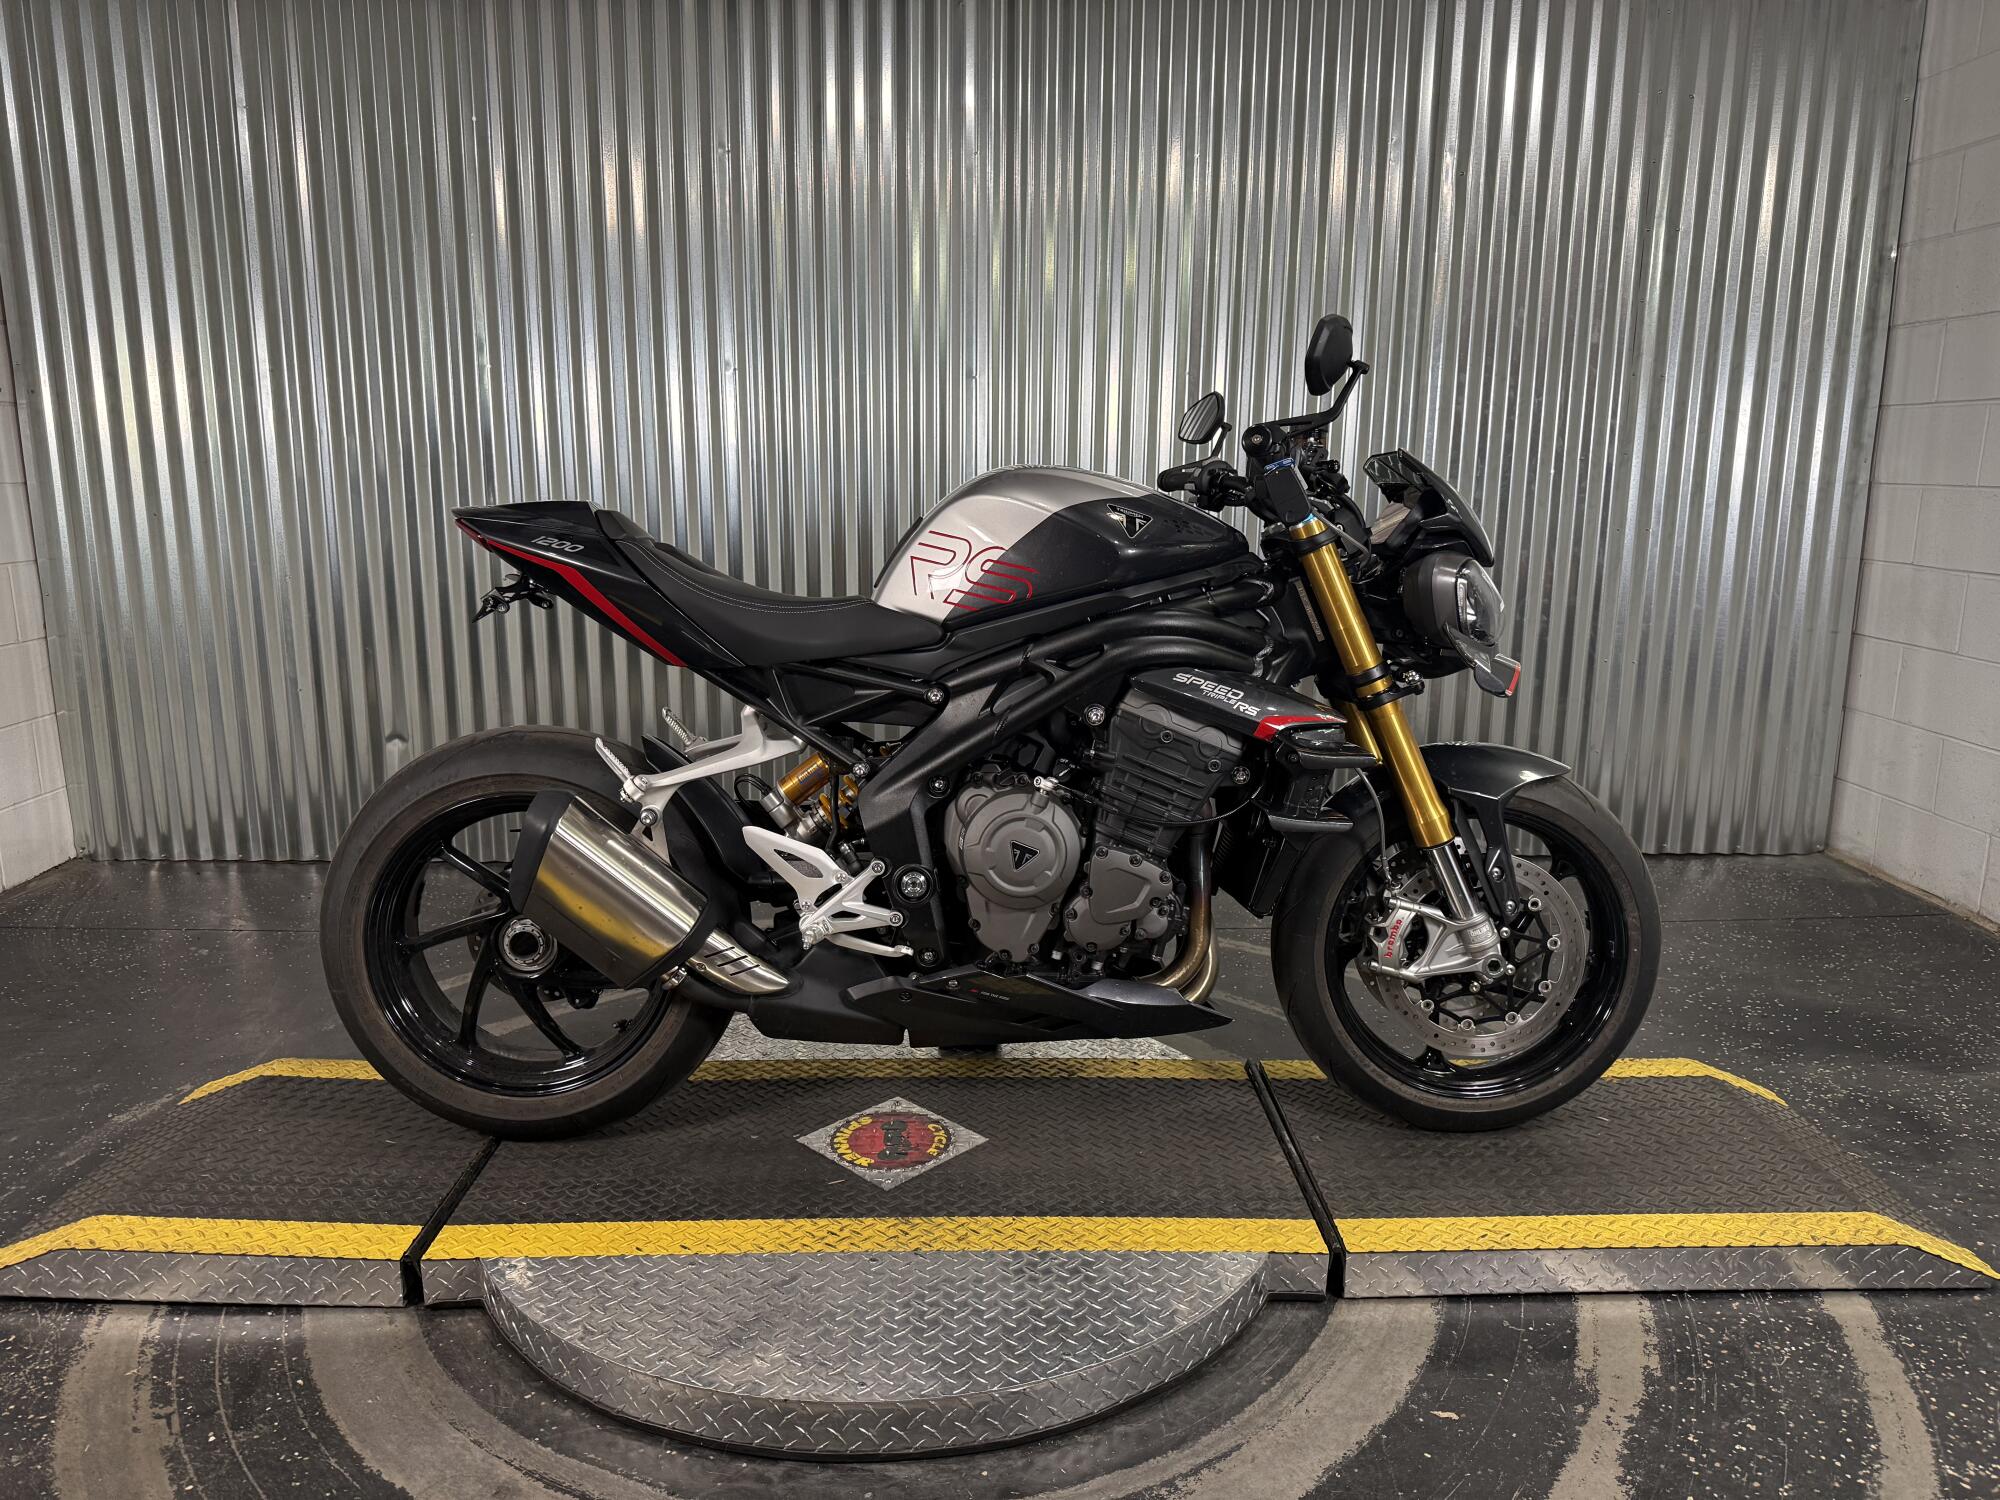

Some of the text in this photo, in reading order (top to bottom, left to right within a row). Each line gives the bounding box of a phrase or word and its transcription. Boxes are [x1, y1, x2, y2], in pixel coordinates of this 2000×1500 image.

[531, 536, 585, 552] 1200
[910, 530, 1040, 611] RS
[1173, 672, 1244, 700] SPEED
[1202, 689, 1261, 717] TRIPLE RS
[1384, 919, 1403, 958] brembo
[833, 1116, 875, 1167] SPINNER
[927, 1123, 947, 1157] CYCLE
